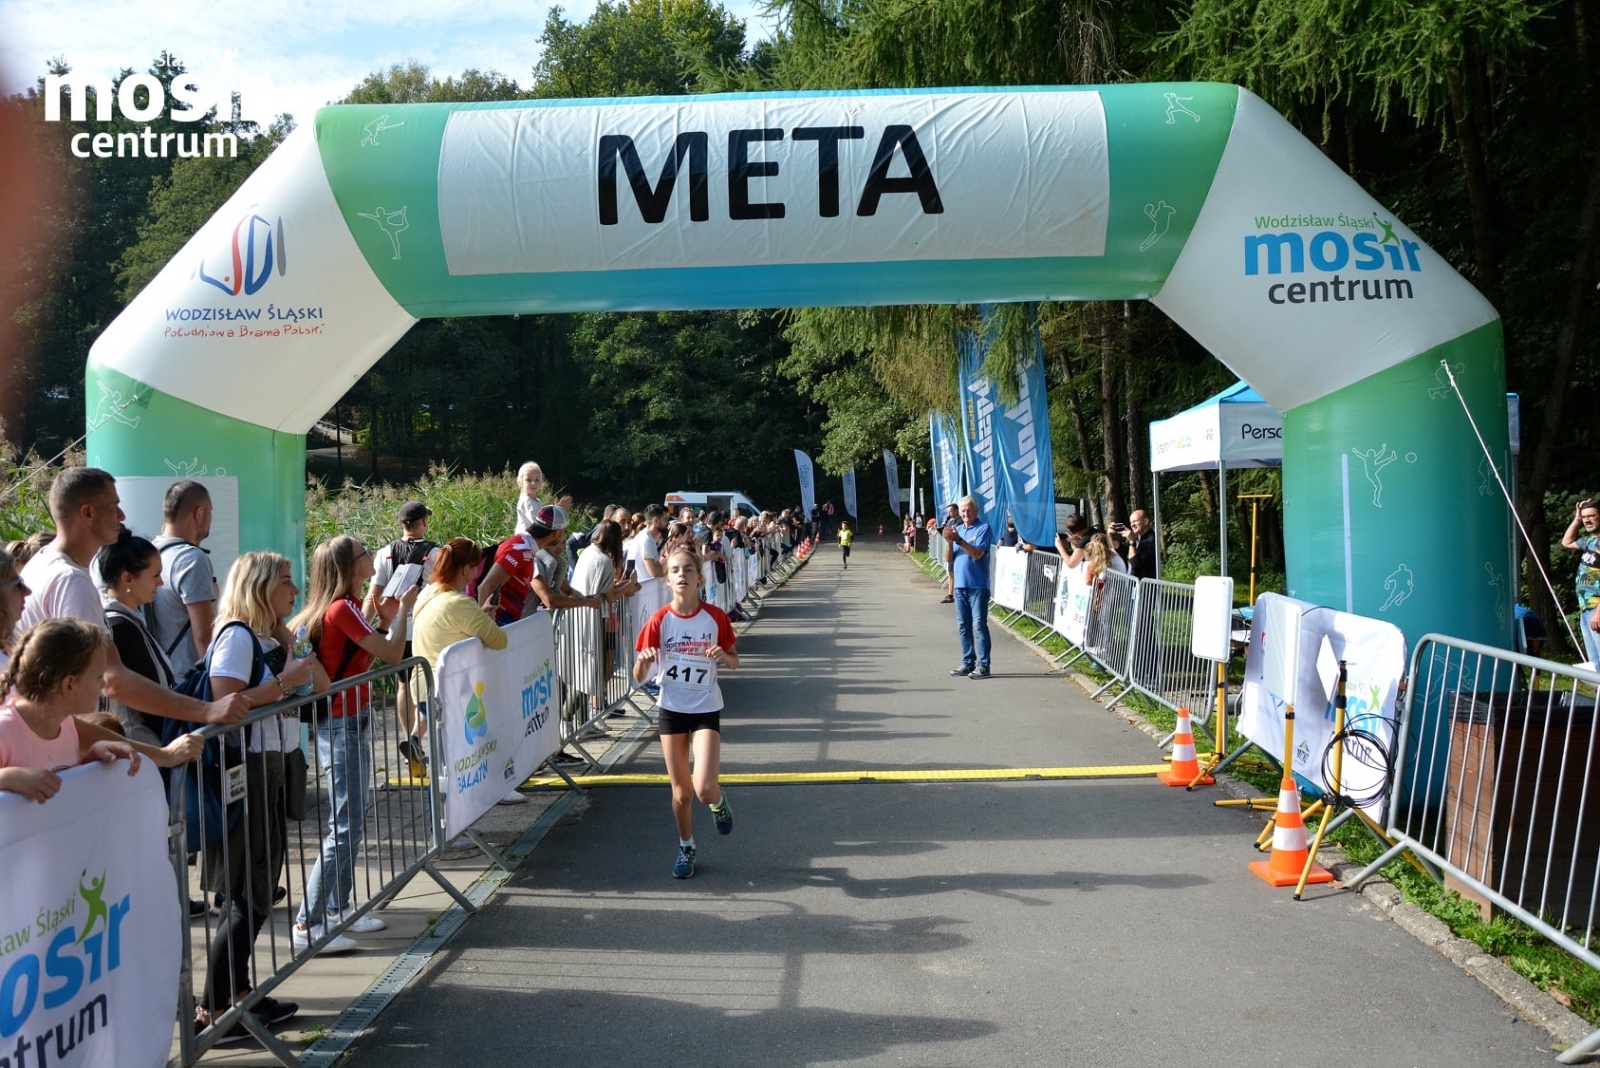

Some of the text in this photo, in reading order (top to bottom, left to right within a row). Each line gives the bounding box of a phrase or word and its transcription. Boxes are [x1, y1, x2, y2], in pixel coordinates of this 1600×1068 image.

[599, 124, 944, 226] META
[1254, 212, 1375, 231] Wodzisław Śląski
[1244, 231, 1422, 276] mosir
[1268, 275, 1414, 305] centrum
[165, 303, 323, 323] WODZISŁAW ŚLĄSKI
[163, 322, 325, 339] Południowa Brama Polski
[666, 664, 708, 684] 417
[36, 893, 76, 937] Śląski
